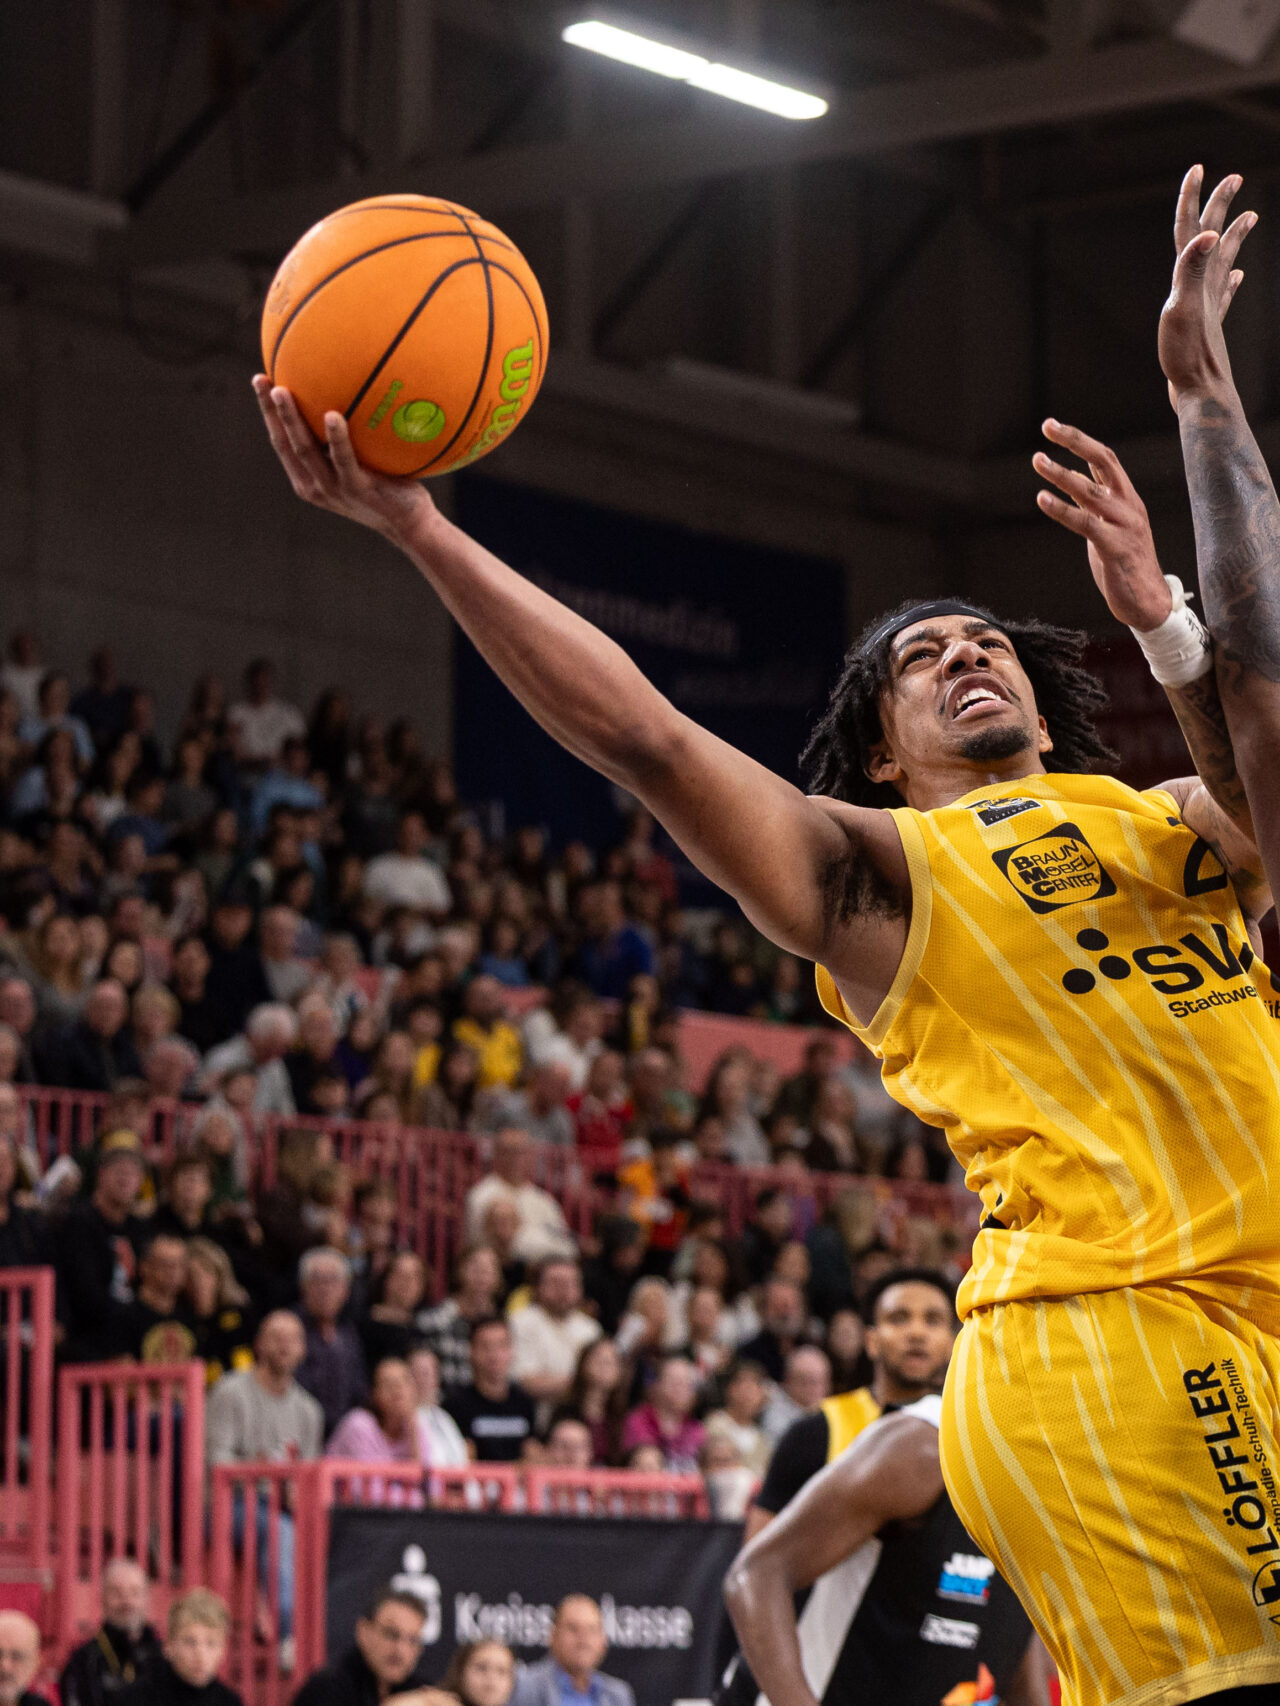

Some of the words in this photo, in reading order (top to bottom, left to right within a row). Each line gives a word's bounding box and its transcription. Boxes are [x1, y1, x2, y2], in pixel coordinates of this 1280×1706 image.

[1011, 839, 1079, 871] BRAUN
[1031, 873, 1100, 897] CENTER
[1168, 985, 1258, 1019] Stadtwe
[1183, 1362, 1280, 1556] LÖFFLER
[454, 1590, 694, 1649] Kreisskasse
